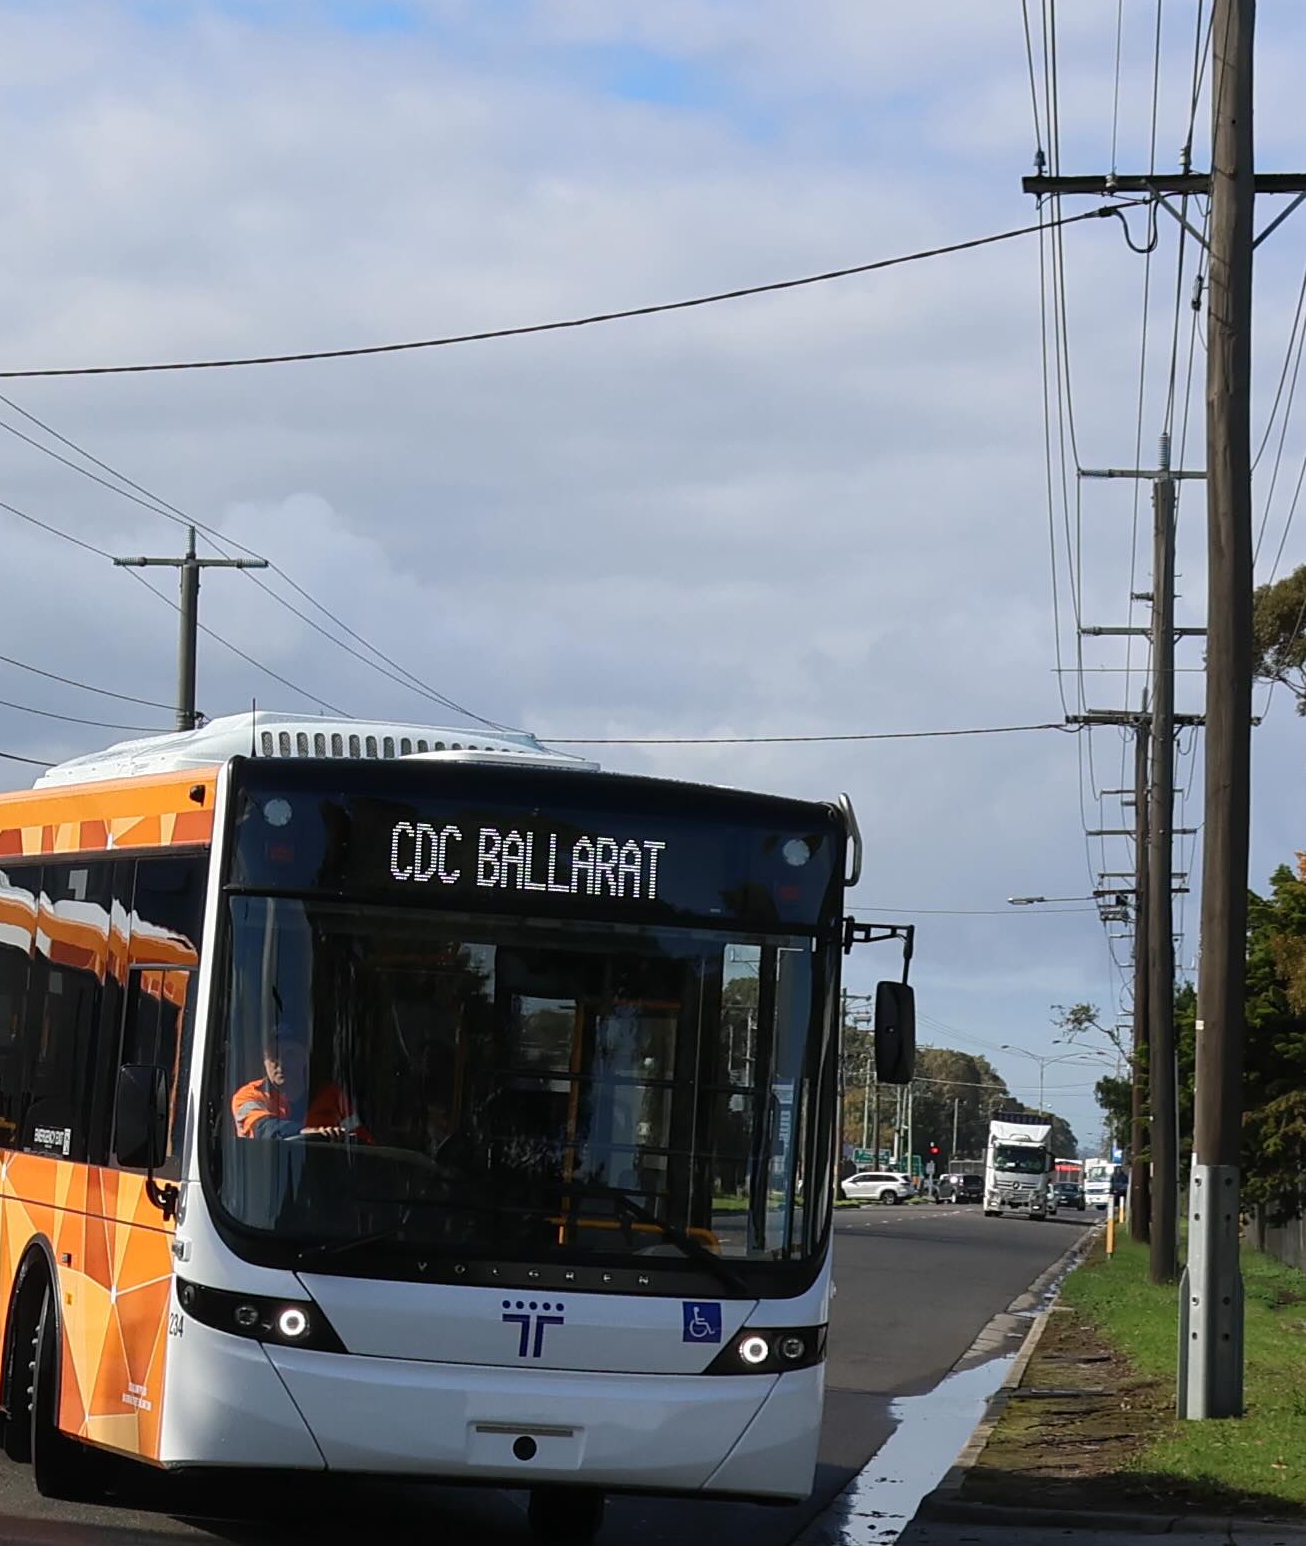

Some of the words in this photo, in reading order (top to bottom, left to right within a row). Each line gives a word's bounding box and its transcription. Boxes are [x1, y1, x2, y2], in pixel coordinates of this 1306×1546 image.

[391, 821, 462, 884] CDC
[477, 827, 666, 899] BALLARAT
[417, 1261, 650, 1286] VOLGREN
[169, 1312, 184, 1338] 234
